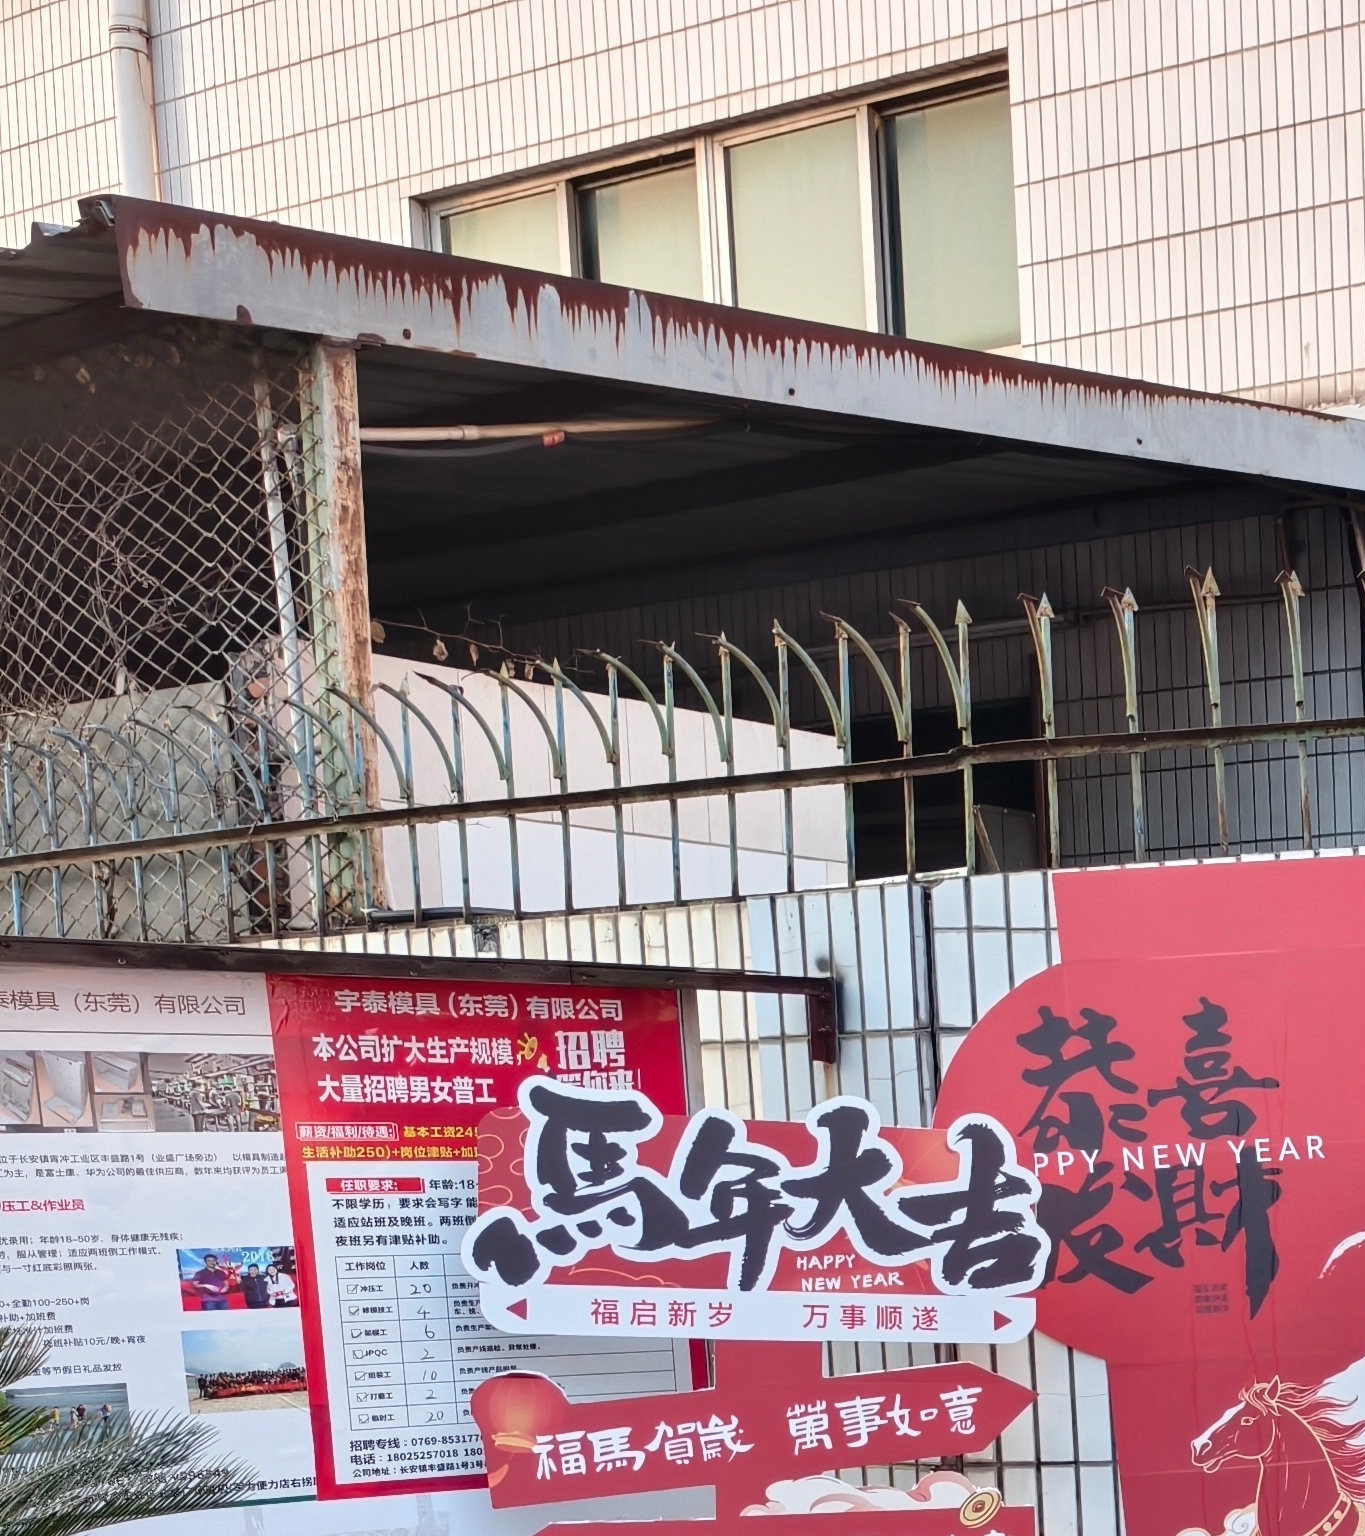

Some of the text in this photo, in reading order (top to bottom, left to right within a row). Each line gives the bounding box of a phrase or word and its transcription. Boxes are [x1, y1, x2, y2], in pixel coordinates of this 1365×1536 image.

[555, 1029, 625, 1070] 招聘
[317, 1076, 497, 1105] 大量招聘男女普工
[403, 1126, 478, 1138] 基本工资24
[1033, 1135, 1326, 1177] PPY NEW YEAR
[0, 1199, 85, 1212] 压工&作业员
[344, 1260, 387, 1272] 工作岗位
[409, 1260, 430, 1271] 人数
[796, 1253, 856, 1271] HAPPY
[801, 1271, 904, 1292] NEW YEAR
[409, 1283, 432, 1296] 20
[416, 1305, 431, 1320] 4
[590, 1298, 939, 1331] 福启新岁 万事顺遂
[424, 1323, 435, 1340] 6
[420, 1349, 435, 1360] 2
[422, 1370, 438, 1381] 10
[425, 1389, 438, 1400] 2
[425, 1410, 444, 1424] 20
[350, 1434, 482, 1452] 招聘专线：0769-853177
[464, 1447, 484, 1457] 180
